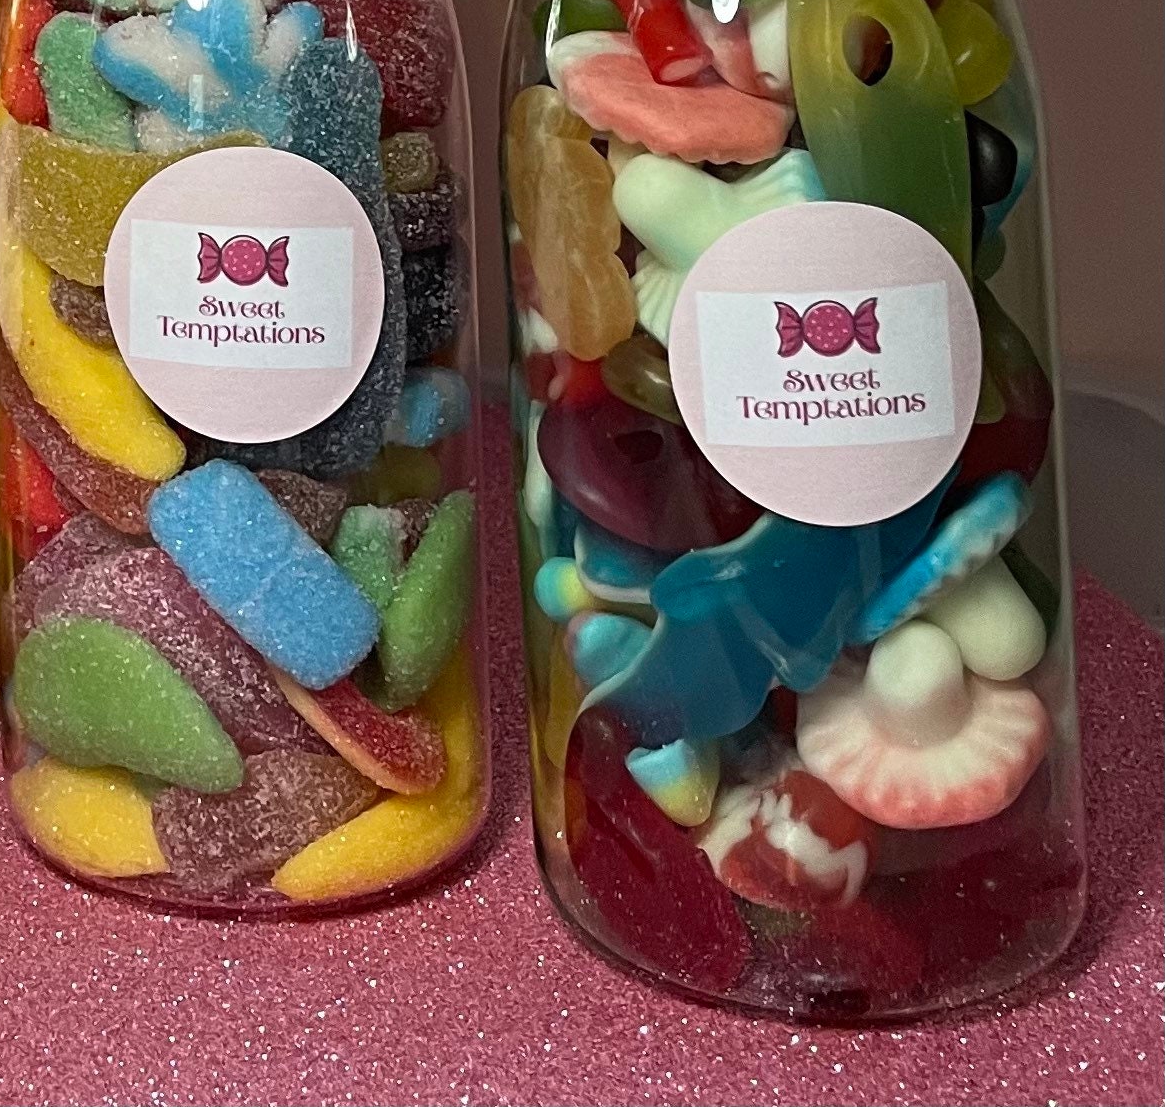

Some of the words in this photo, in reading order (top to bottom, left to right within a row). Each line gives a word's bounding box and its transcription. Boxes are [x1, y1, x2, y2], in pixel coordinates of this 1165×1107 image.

[198, 295, 285, 319] Sweet
[156, 314, 325, 347] Temptations
[782, 368, 881, 393] Sweet
[736, 391, 926, 425] Temptations
